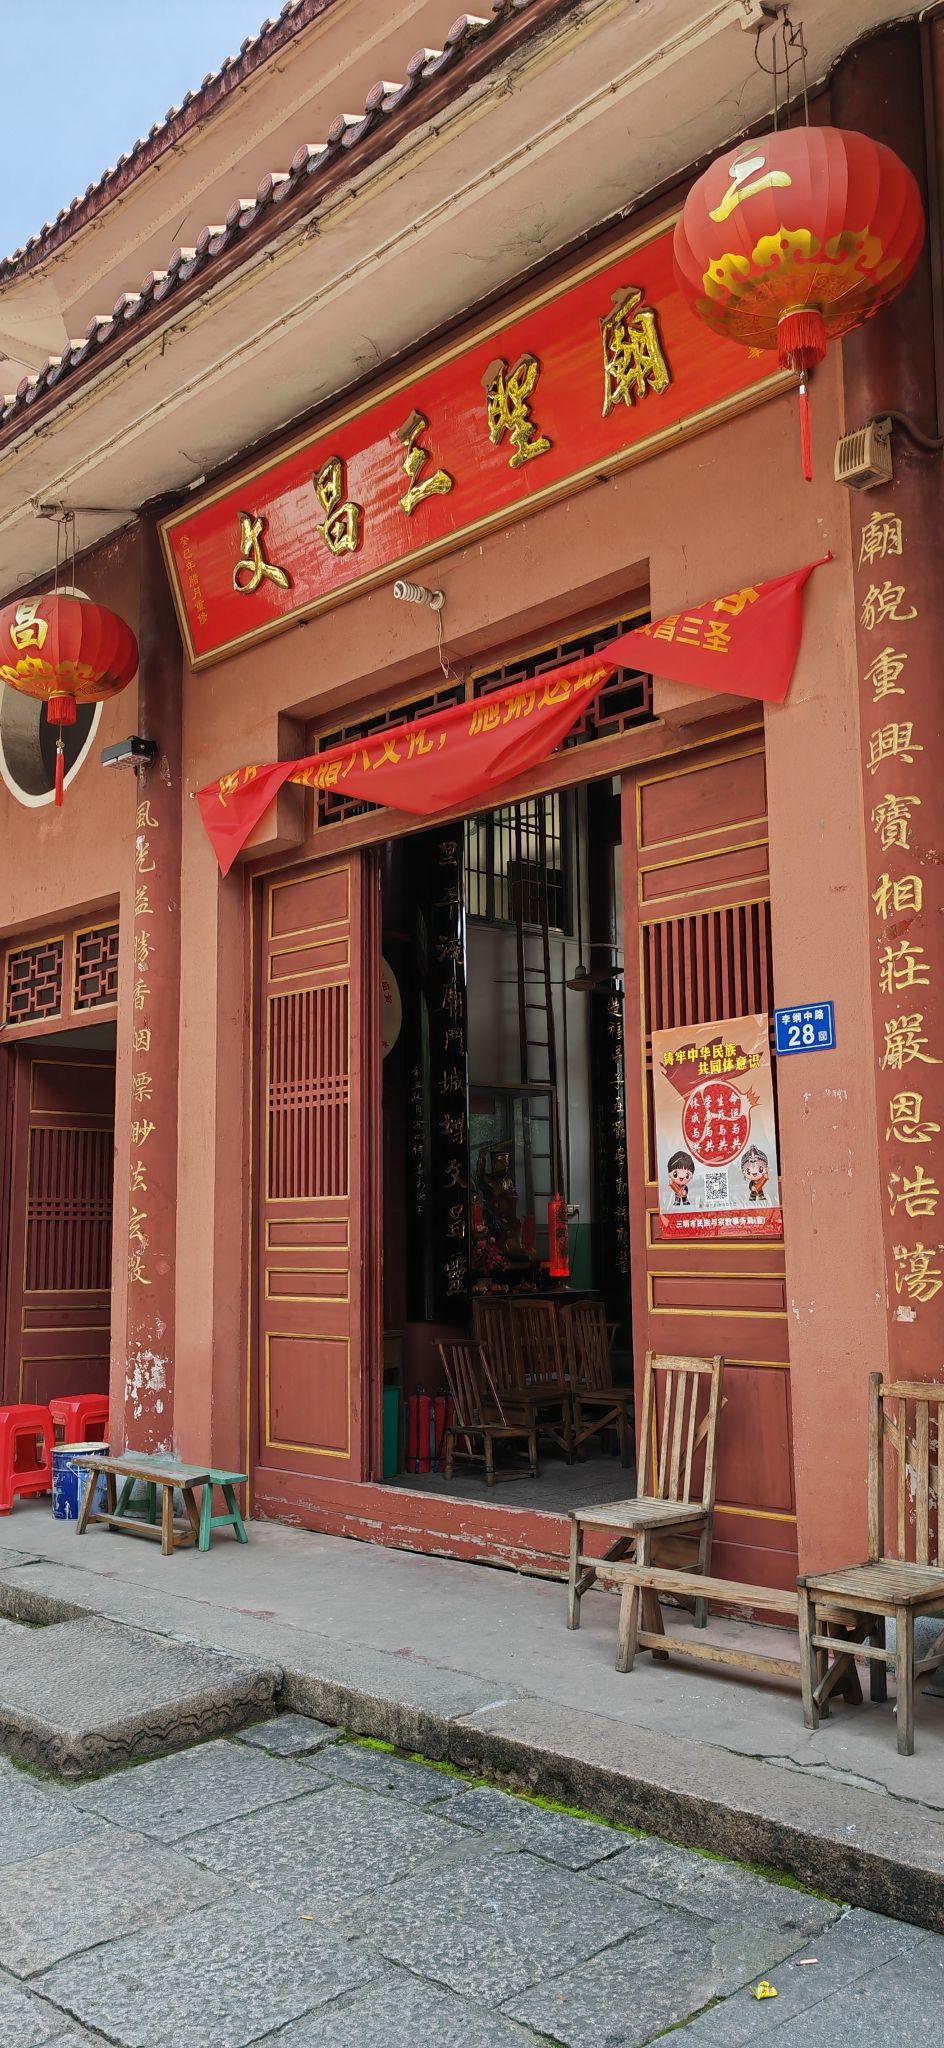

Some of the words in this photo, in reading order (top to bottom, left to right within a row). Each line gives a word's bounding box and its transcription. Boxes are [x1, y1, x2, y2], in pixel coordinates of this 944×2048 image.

[708, 139, 793, 223] 三
[10, 598, 49, 651] 昌
[781, 1008, 824, 1025] 李纲中路
[788, 1023, 815, 1047] 28
[662, 1042, 737, 1066] 铸牢中华民族
[697, 1054, 760, 1075] 共同体意识
